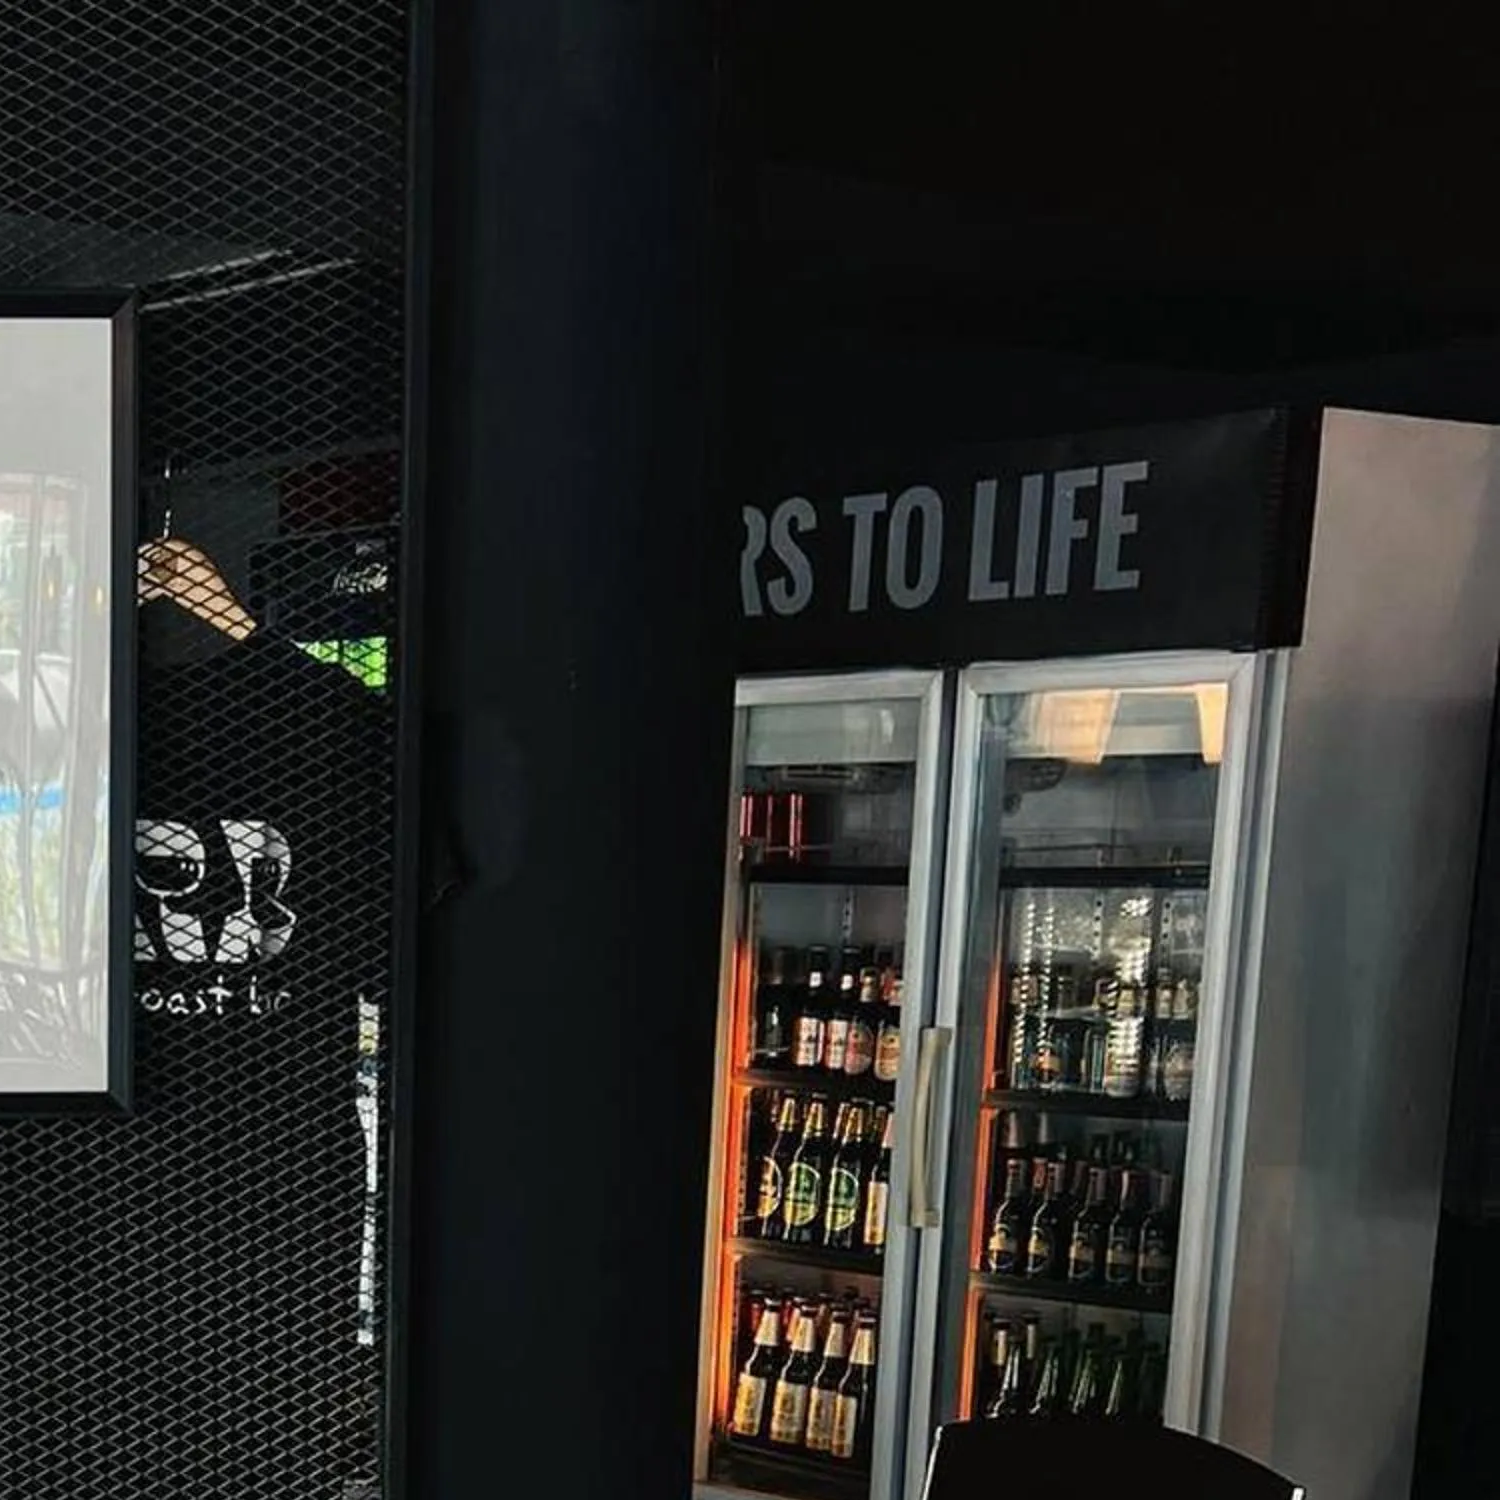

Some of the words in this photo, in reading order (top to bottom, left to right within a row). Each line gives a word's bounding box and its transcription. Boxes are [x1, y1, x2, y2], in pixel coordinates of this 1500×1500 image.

[842, 485, 944, 612] TO
[967, 460, 1150, 602] LIFE
[134, 975, 234, 1015] oast
